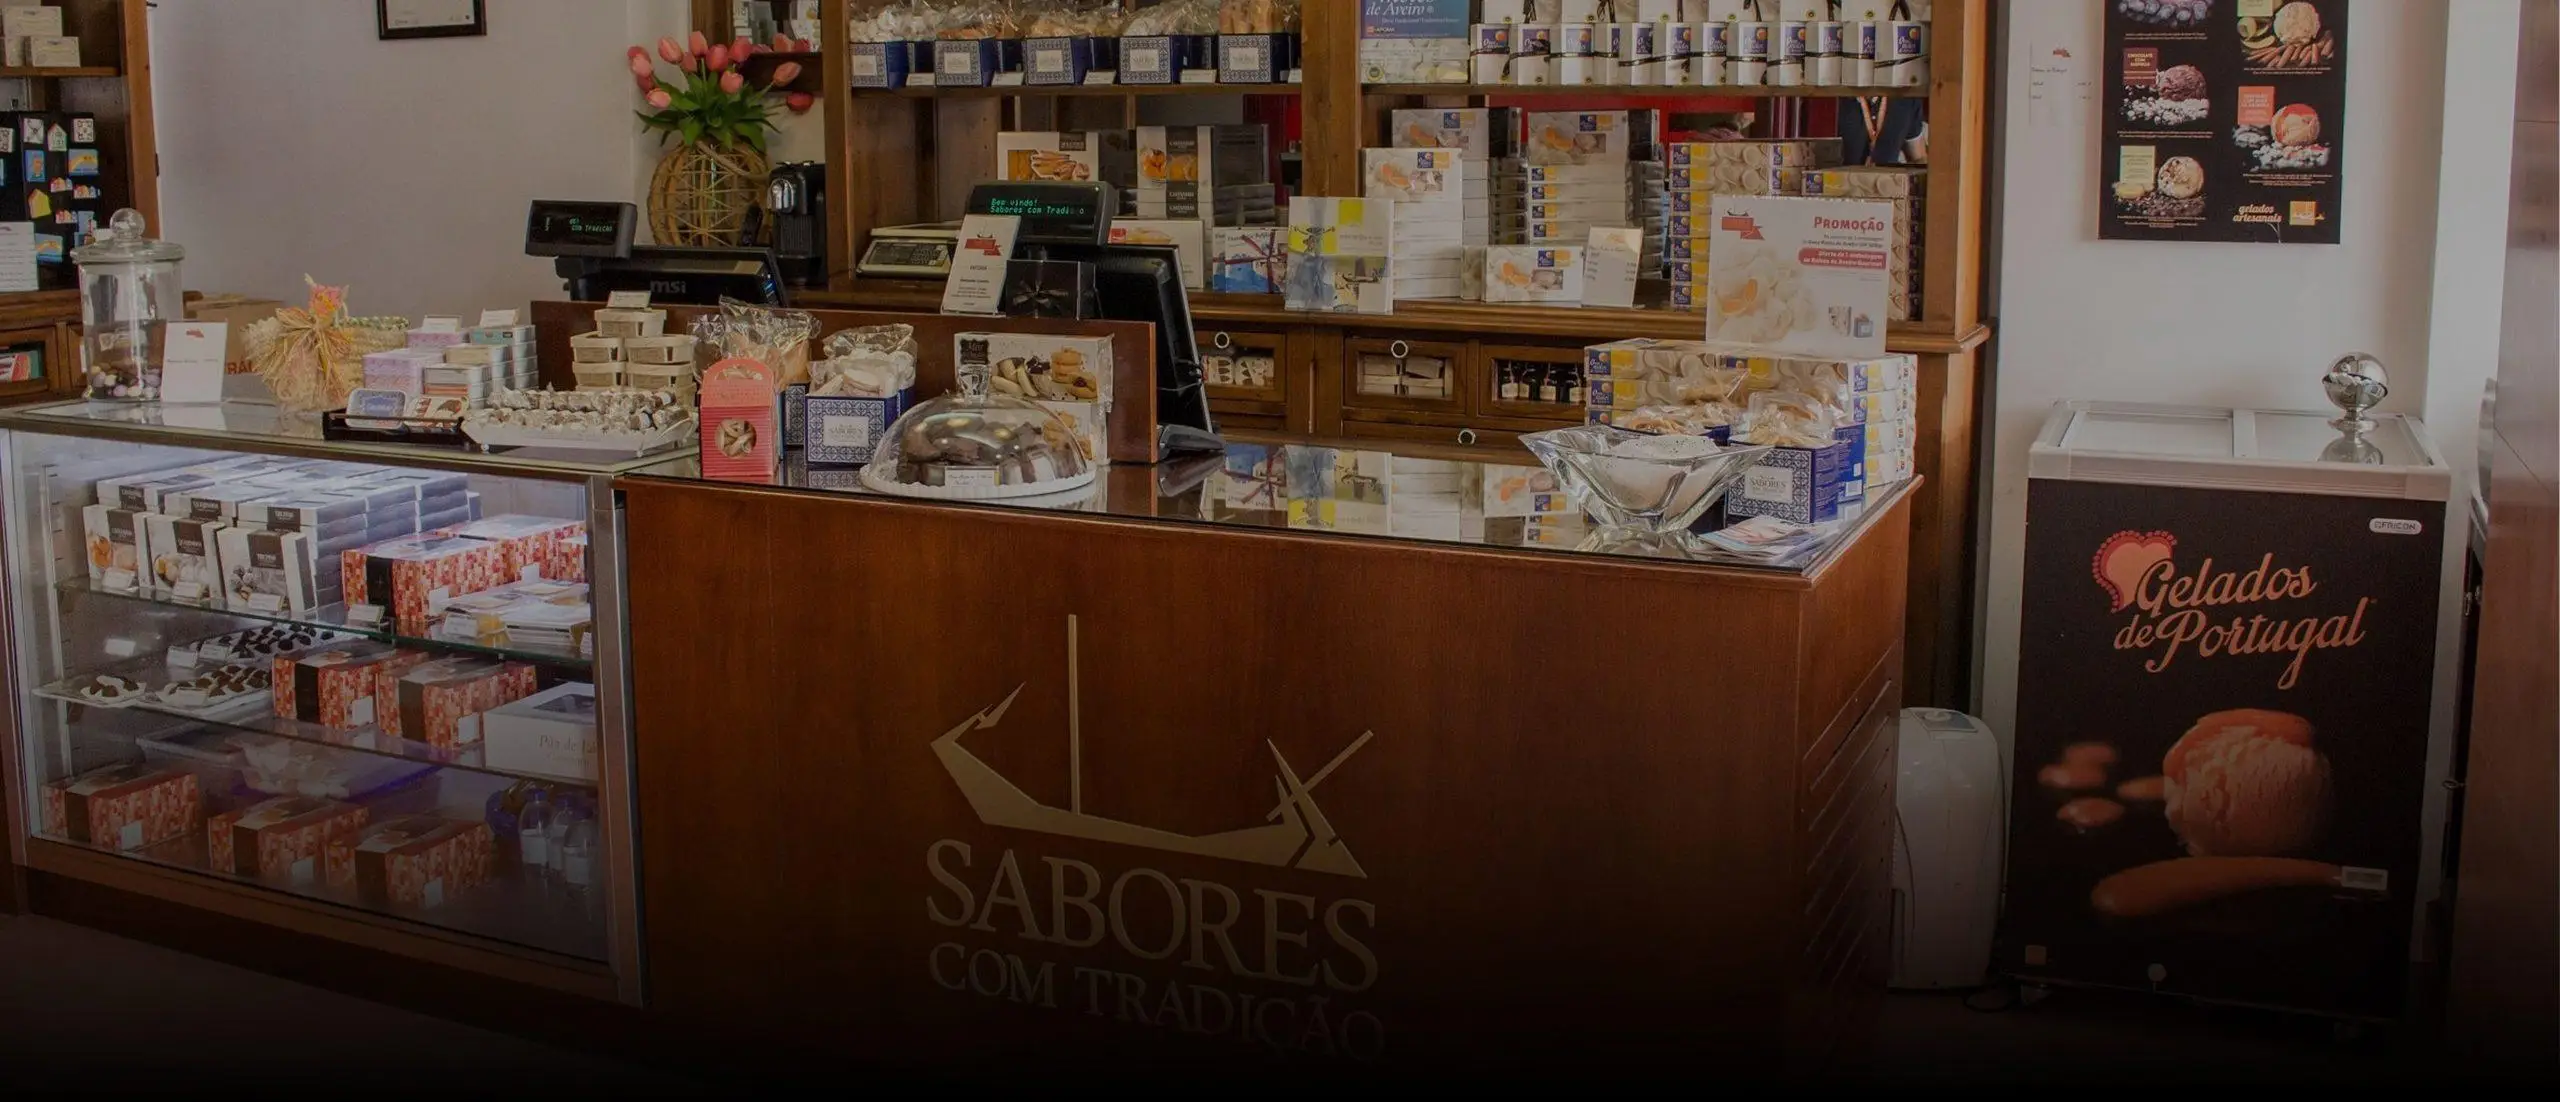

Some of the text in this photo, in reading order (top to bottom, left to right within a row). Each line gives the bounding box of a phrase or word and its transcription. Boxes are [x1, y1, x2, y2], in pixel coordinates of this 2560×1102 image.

[1365, 2, 1425, 16] de Aveiro
[2136, 552, 2317, 618] Gelados
[2113, 597, 2369, 690] de Portugal
[926, 838, 1379, 993] SABORES
[928, 942, 1387, 1065] COM TRADIÇÃO
